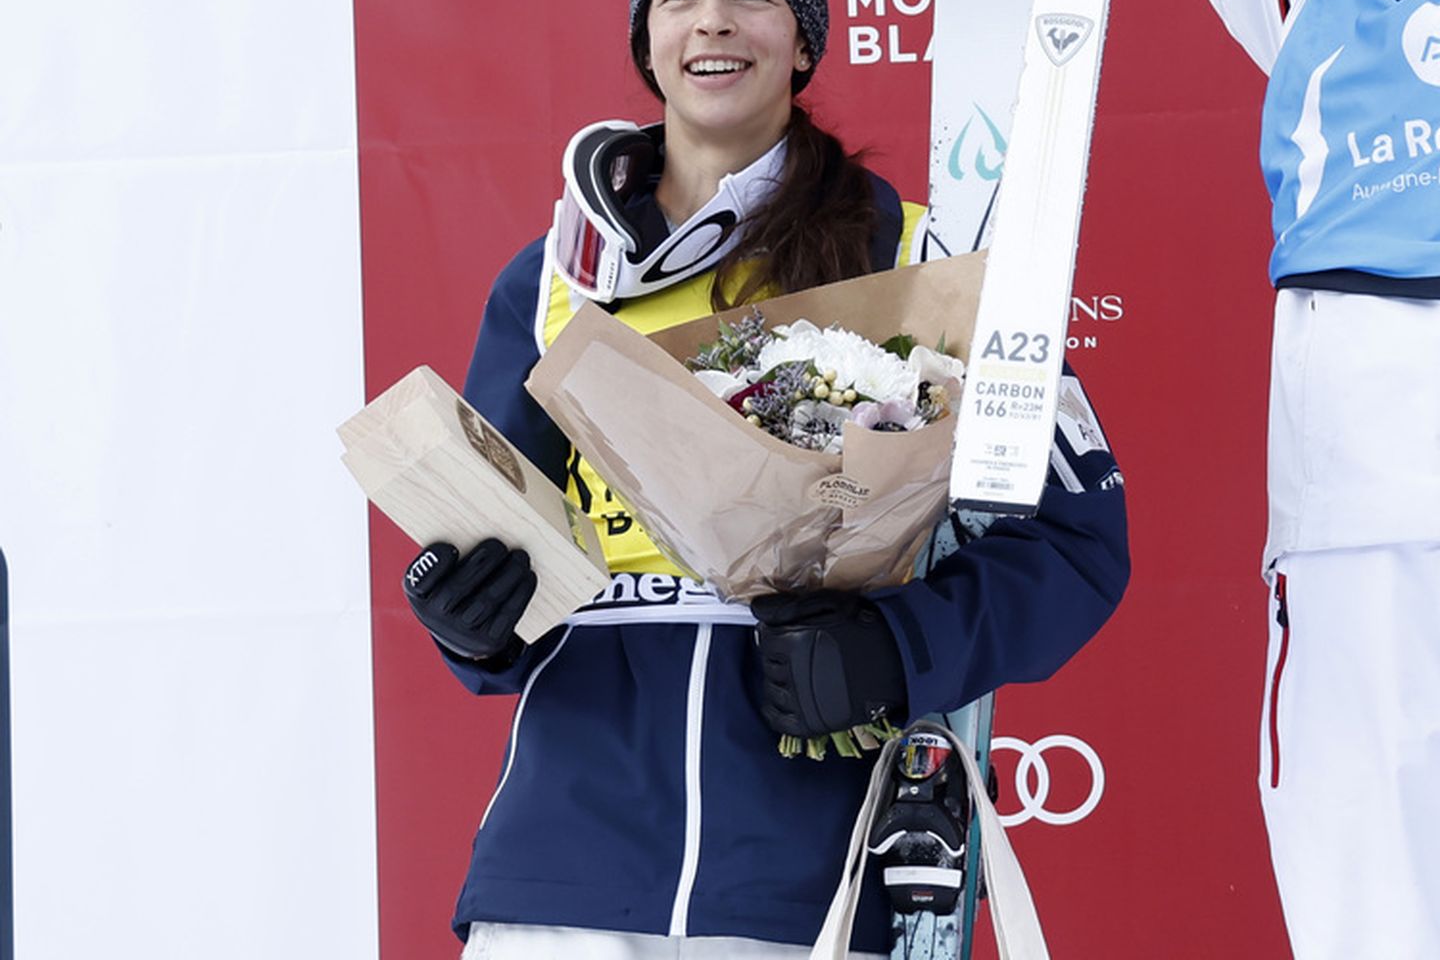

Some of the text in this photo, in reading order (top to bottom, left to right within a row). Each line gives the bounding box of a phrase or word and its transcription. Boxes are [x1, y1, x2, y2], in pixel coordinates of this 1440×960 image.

[848, 24, 934, 65] BL
[1346, 131, 1396, 168] La
[981, 330, 1050, 364] A23
[975, 381, 1046, 400] CARBON
[974, 399, 1007, 418] 166
[405, 550, 438, 587] XTM
